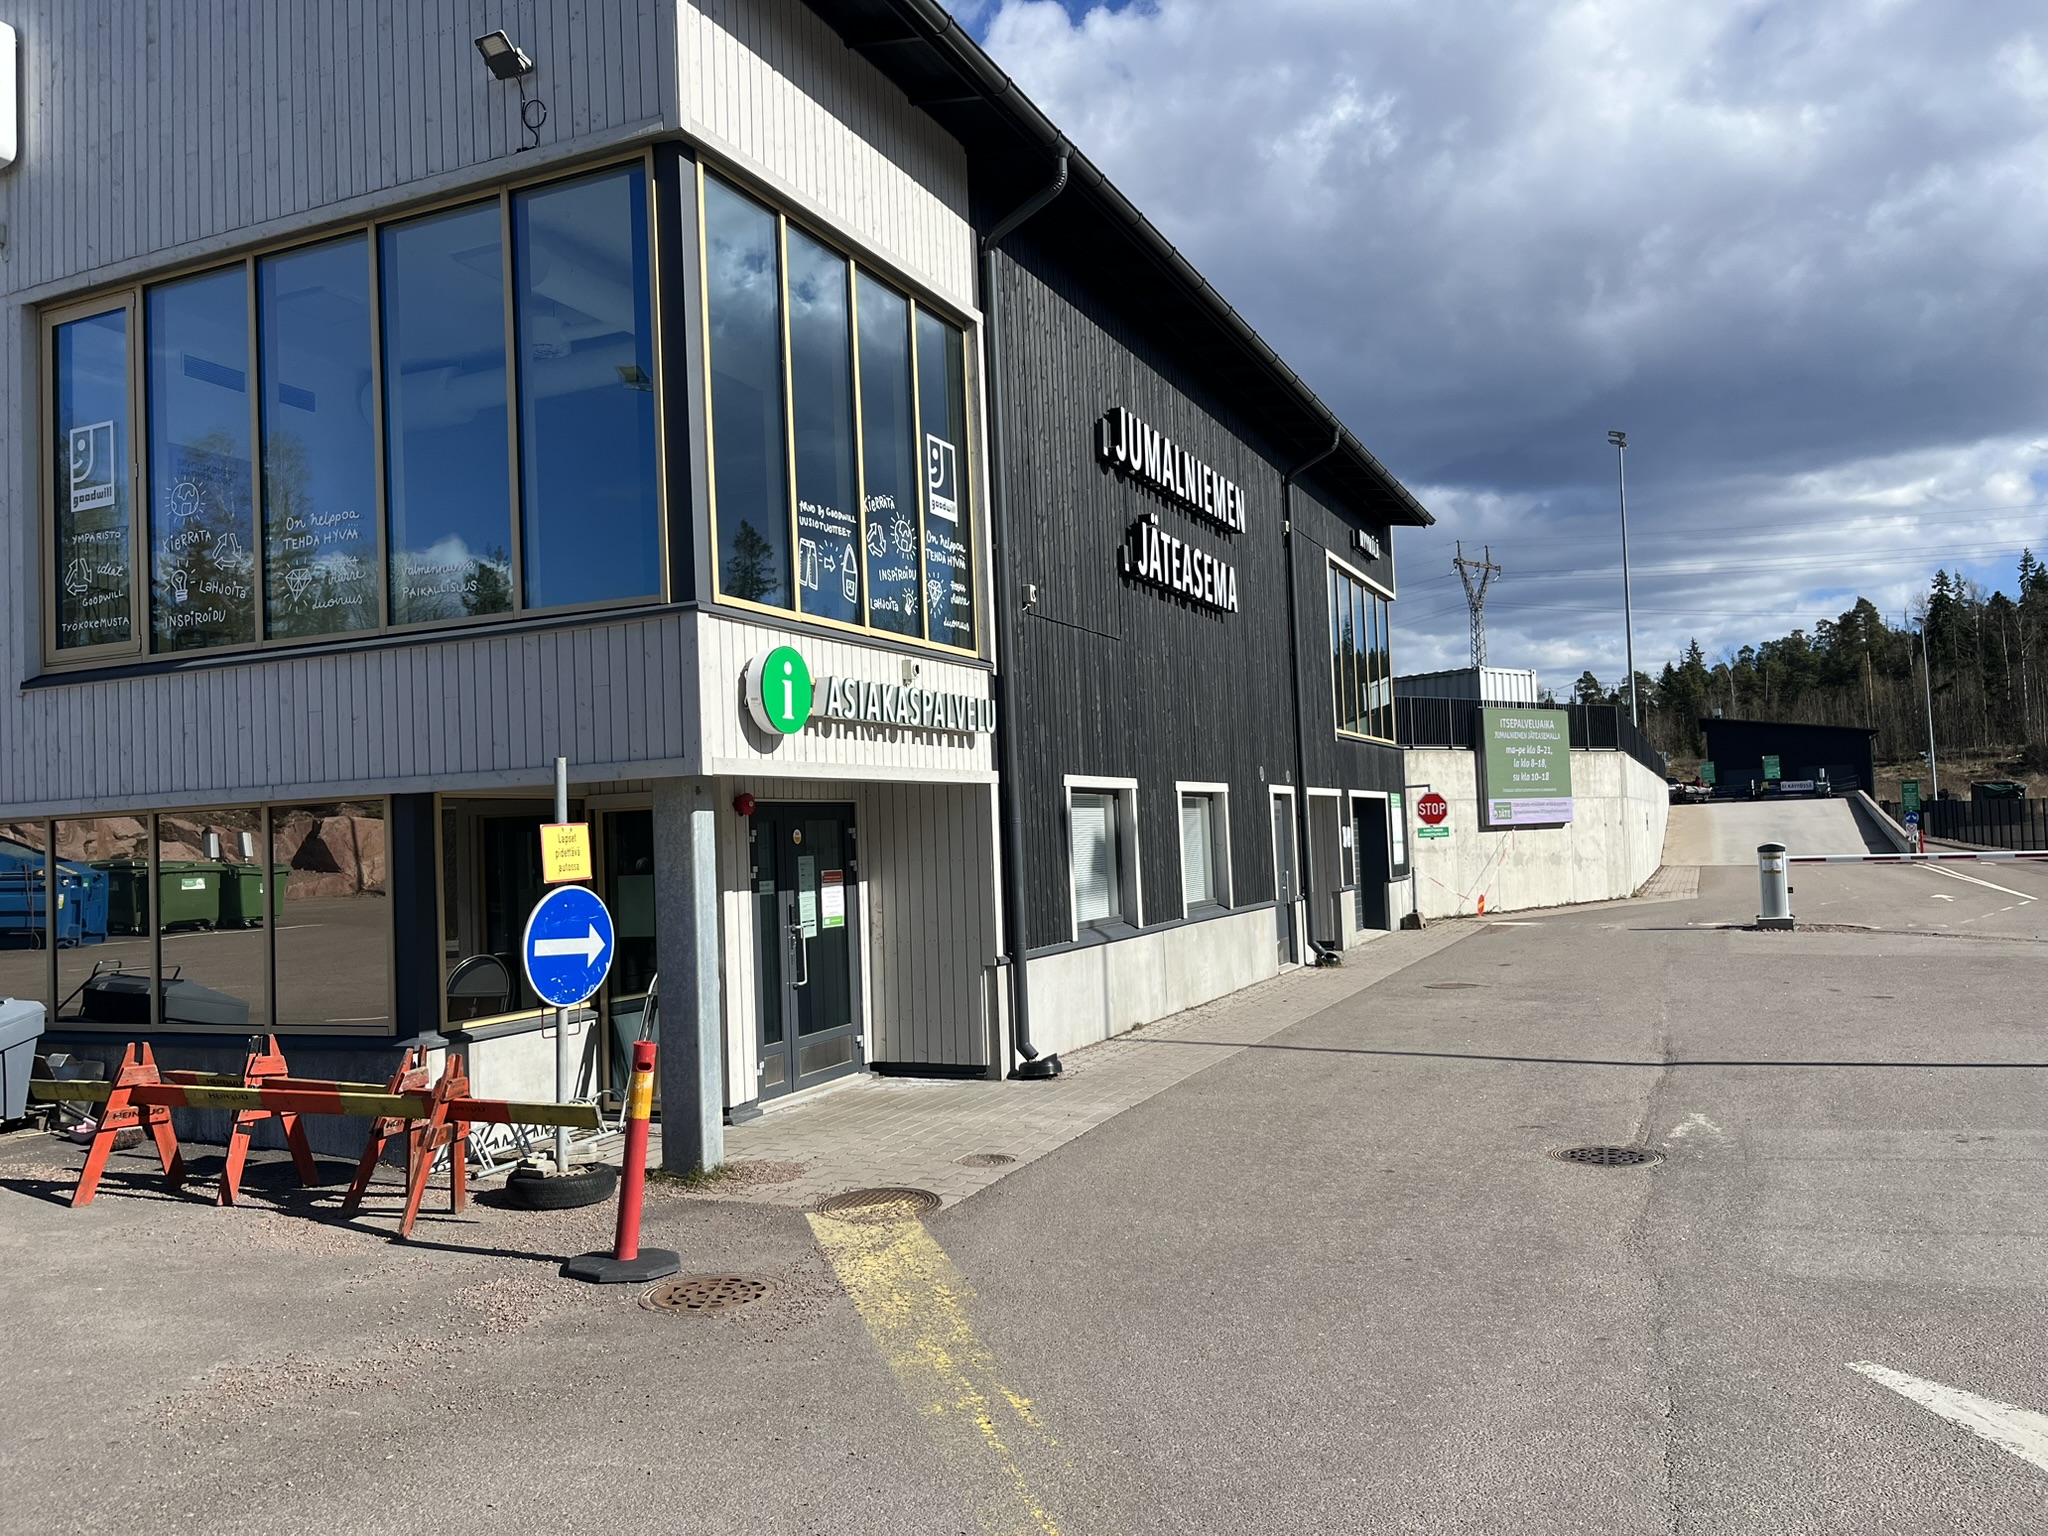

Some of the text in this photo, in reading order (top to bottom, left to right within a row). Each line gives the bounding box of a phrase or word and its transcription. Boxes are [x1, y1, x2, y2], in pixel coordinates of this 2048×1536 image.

[1116, 406, 1245, 533] JUMALNIEMEN
[73, 486, 112, 508] goodwill
[286, 511, 360, 531] On helppoa
[283, 523, 359, 550] TEHDÄ HYVÄÄ
[1138, 513, 1239, 613] JÄTEASEMA
[82, 590, 124, 607] GOODWILL
[827, 675, 996, 734] ASIAKASPALVELU
[1499, 718, 1555, 729] ITSEPALVELUAIKA
[1526, 745, 1536, 754] klo
[1520, 758, 1530, 768] klo
[1512, 773, 1520, 782] su
[1520, 772, 1531, 781] klo
[1418, 803, 1446, 815] STOP
[557, 833, 577, 846] Lapset
[555, 846, 580, 860] pidettävä
[558, 862, 580, 873] autossa
[208, 1091, 249, 1101] HEINSUO
